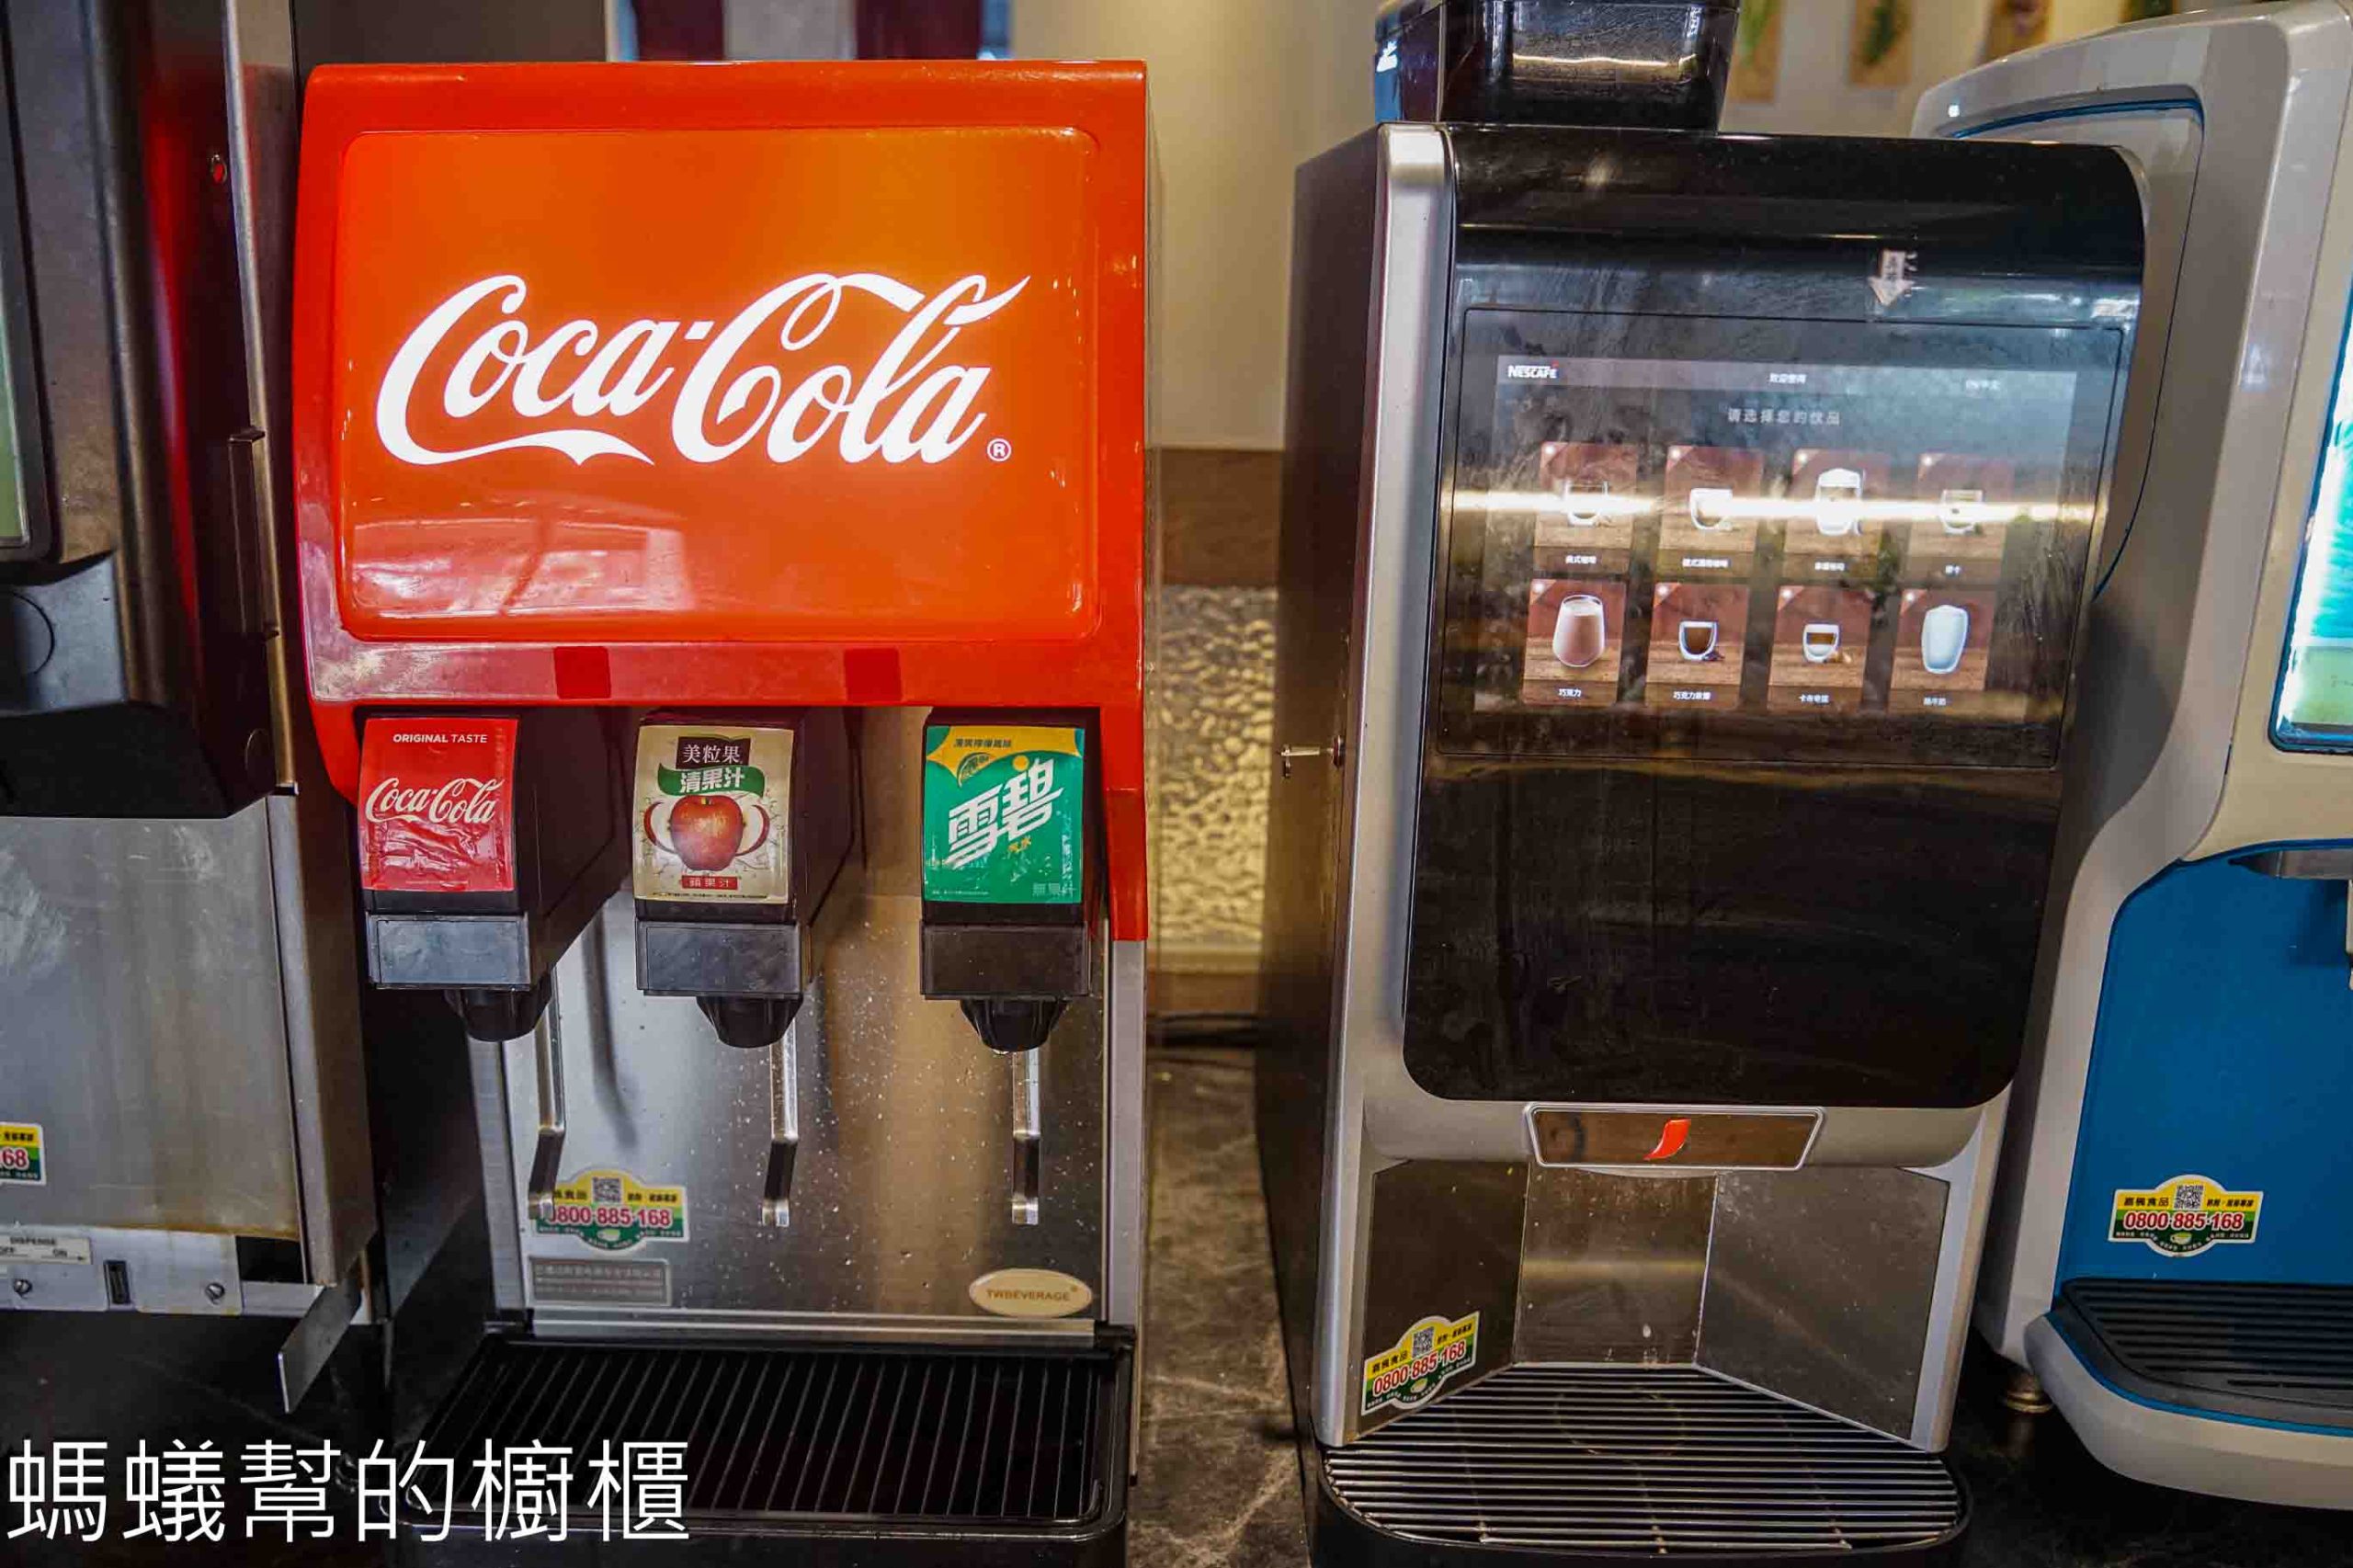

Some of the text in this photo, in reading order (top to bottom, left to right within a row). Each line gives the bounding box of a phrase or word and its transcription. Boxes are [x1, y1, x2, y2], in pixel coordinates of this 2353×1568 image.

[376, 272, 1031, 466] Coca-Cola
[392, 733, 488, 744] ORIGINAL TASTE
[683, 744, 740, 765] 美粒果
[679, 767, 745, 793] 清果汁
[365, 777, 506, 824] Coca-Cola
[944, 757, 1064, 870] 雪碧
[0, 1148, 28, 1169] 68
